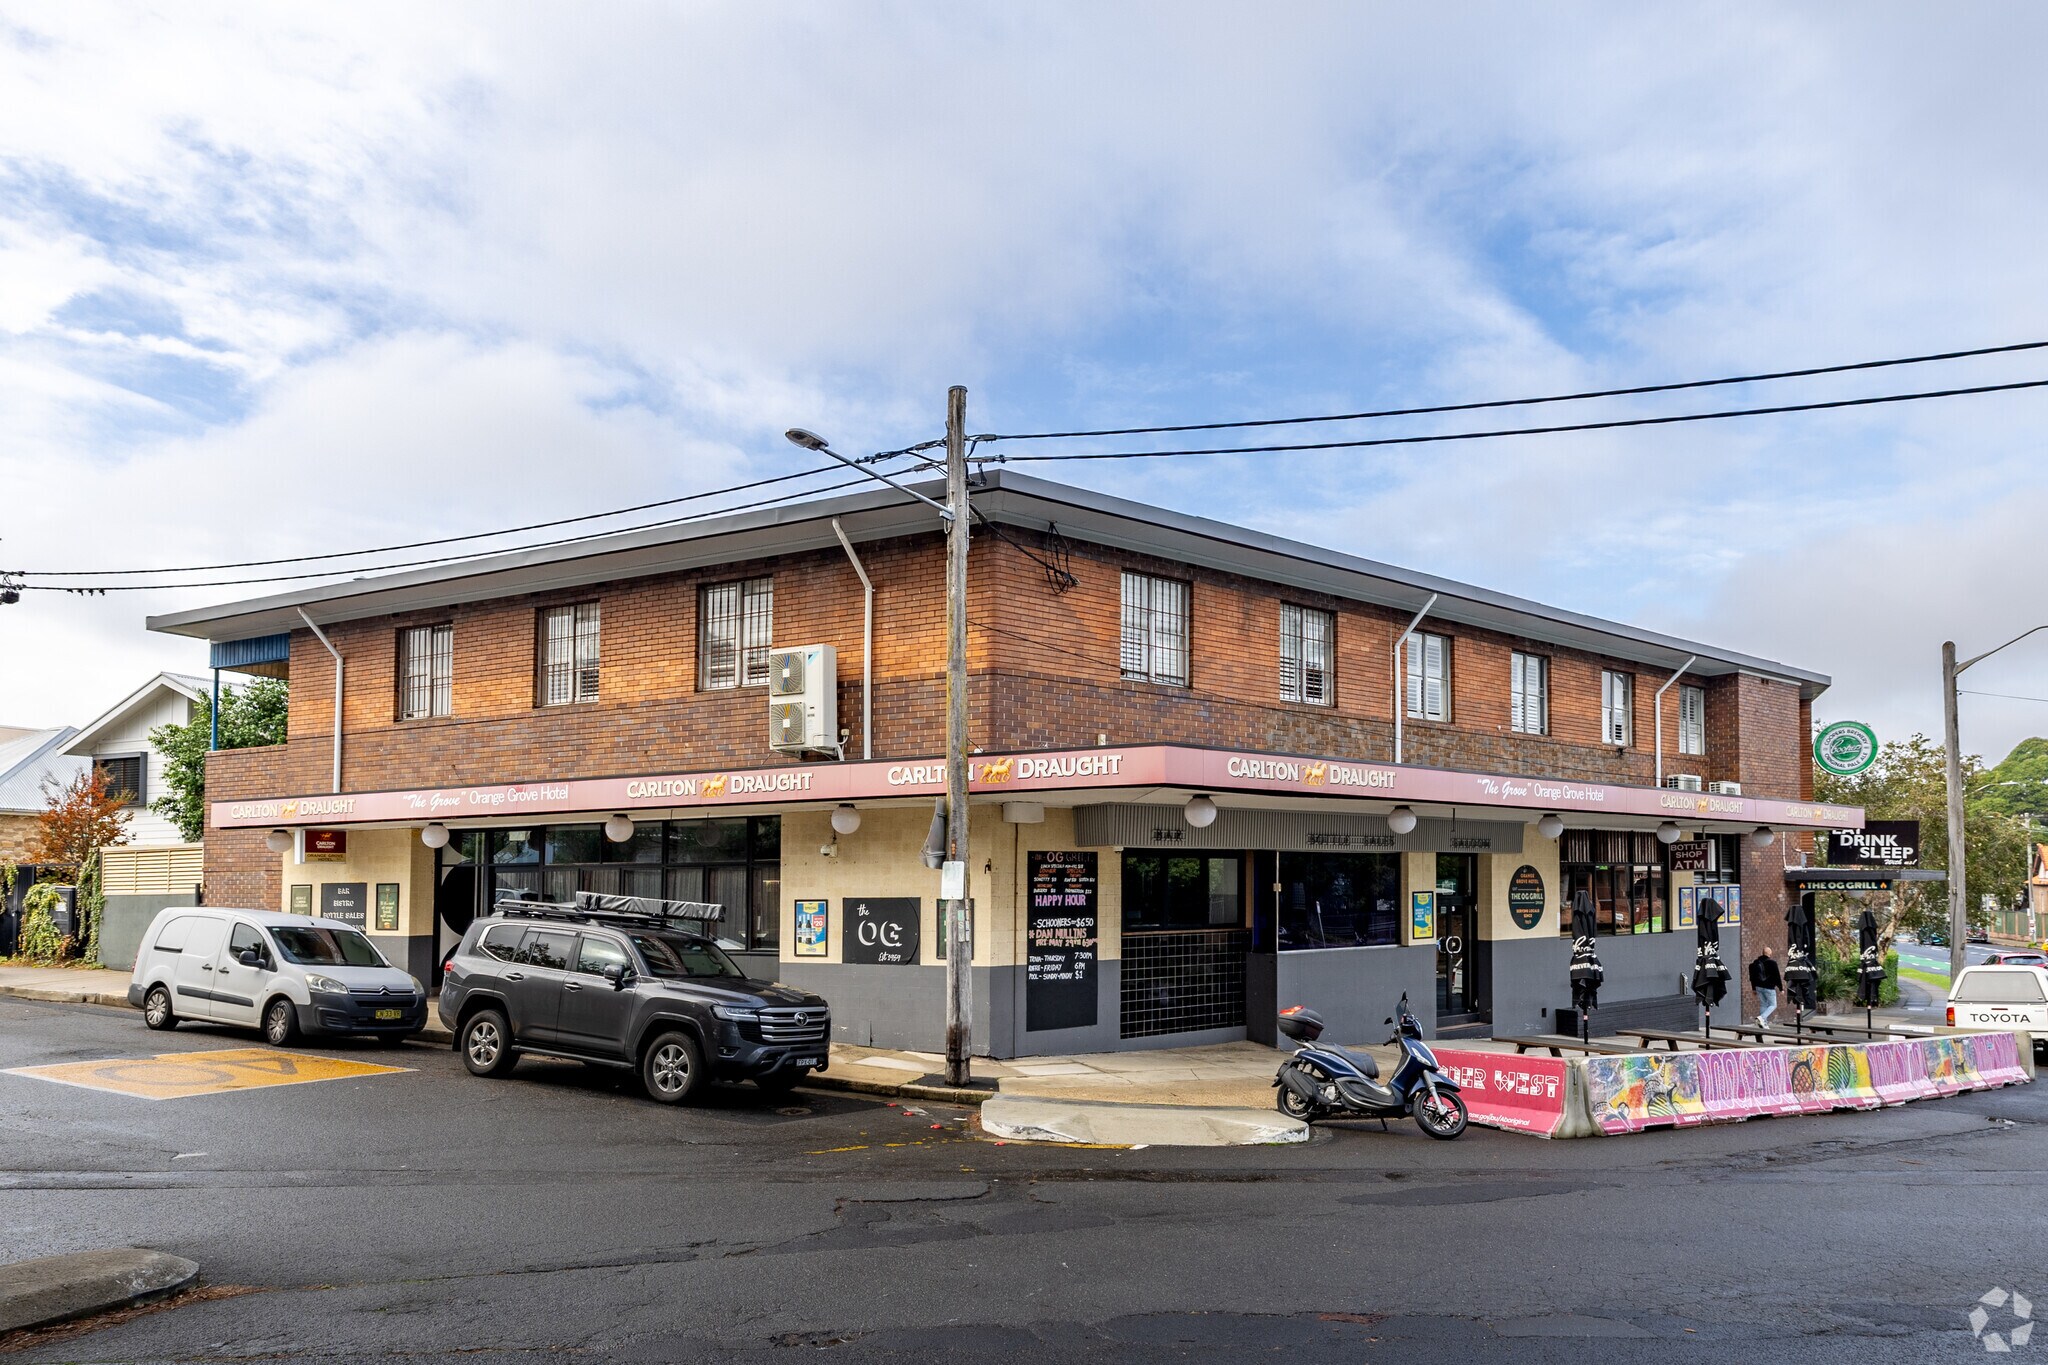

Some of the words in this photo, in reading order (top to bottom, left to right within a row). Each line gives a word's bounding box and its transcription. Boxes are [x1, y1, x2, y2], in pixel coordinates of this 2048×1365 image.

[1825, 729, 1845, 745] COOPERS
[1847, 729, 1868, 744] BREWERY
[1825, 753, 1846, 768] ORIGINAL
[1848, 760, 1861, 768] PALE
[887, 763, 975, 785] CARLT
[1017, 754, 1124, 780] DRAUGHT
[1227, 756, 1300, 781] CARLTON
[1329, 764, 1396, 788] DRAUGHT
[627, 779, 698, 798] CARLTON
[730, 772, 813, 794] DRAUGHT
[1534, 783, 1561, 800] Orange
[1562, 785, 1585, 800] Grove
[1585, 787, 1604, 801] Hotel
[469, 790, 504, 805] Orange
[507, 787, 538, 802] Grove
[540, 785, 569, 800] Hotel
[231, 804, 279, 819] CARLTON
[300, 799, 356, 816] DRAUGHT
[1660, 796, 1695, 811] CARLTON
[1709, 799, 1744, 814] DRAUGHT
[1786, 805, 1813, 818] CARLTON
[1823, 808, 1850, 822] DRAUGHT
[1154, 829, 1184, 842] BAR
[1840, 834, 1898, 847] DRINK
[1670, 843, 1708, 851] BOTTLE
[1860, 847, 1914, 859] SLEEP
[1047, 852, 1064, 863] OG
[1674, 860, 1705, 870] ATM
[1035, 894, 1063, 906] HAPPY
[1065, 894, 1086, 906] HOUR
[857, 903, 870, 916] the
[858, 920, 903, 947] OG
[1036, 929, 1053, 939] DAN
[1044, 964, 1062, 972] FRIDAY
[1074, 962, 1085, 970] 6PM
[1075, 970, 1083, 980] $1
[1970, 1013, 2031, 1023] TOYOTA
[1494, 1070, 1559, 1098] WEST
